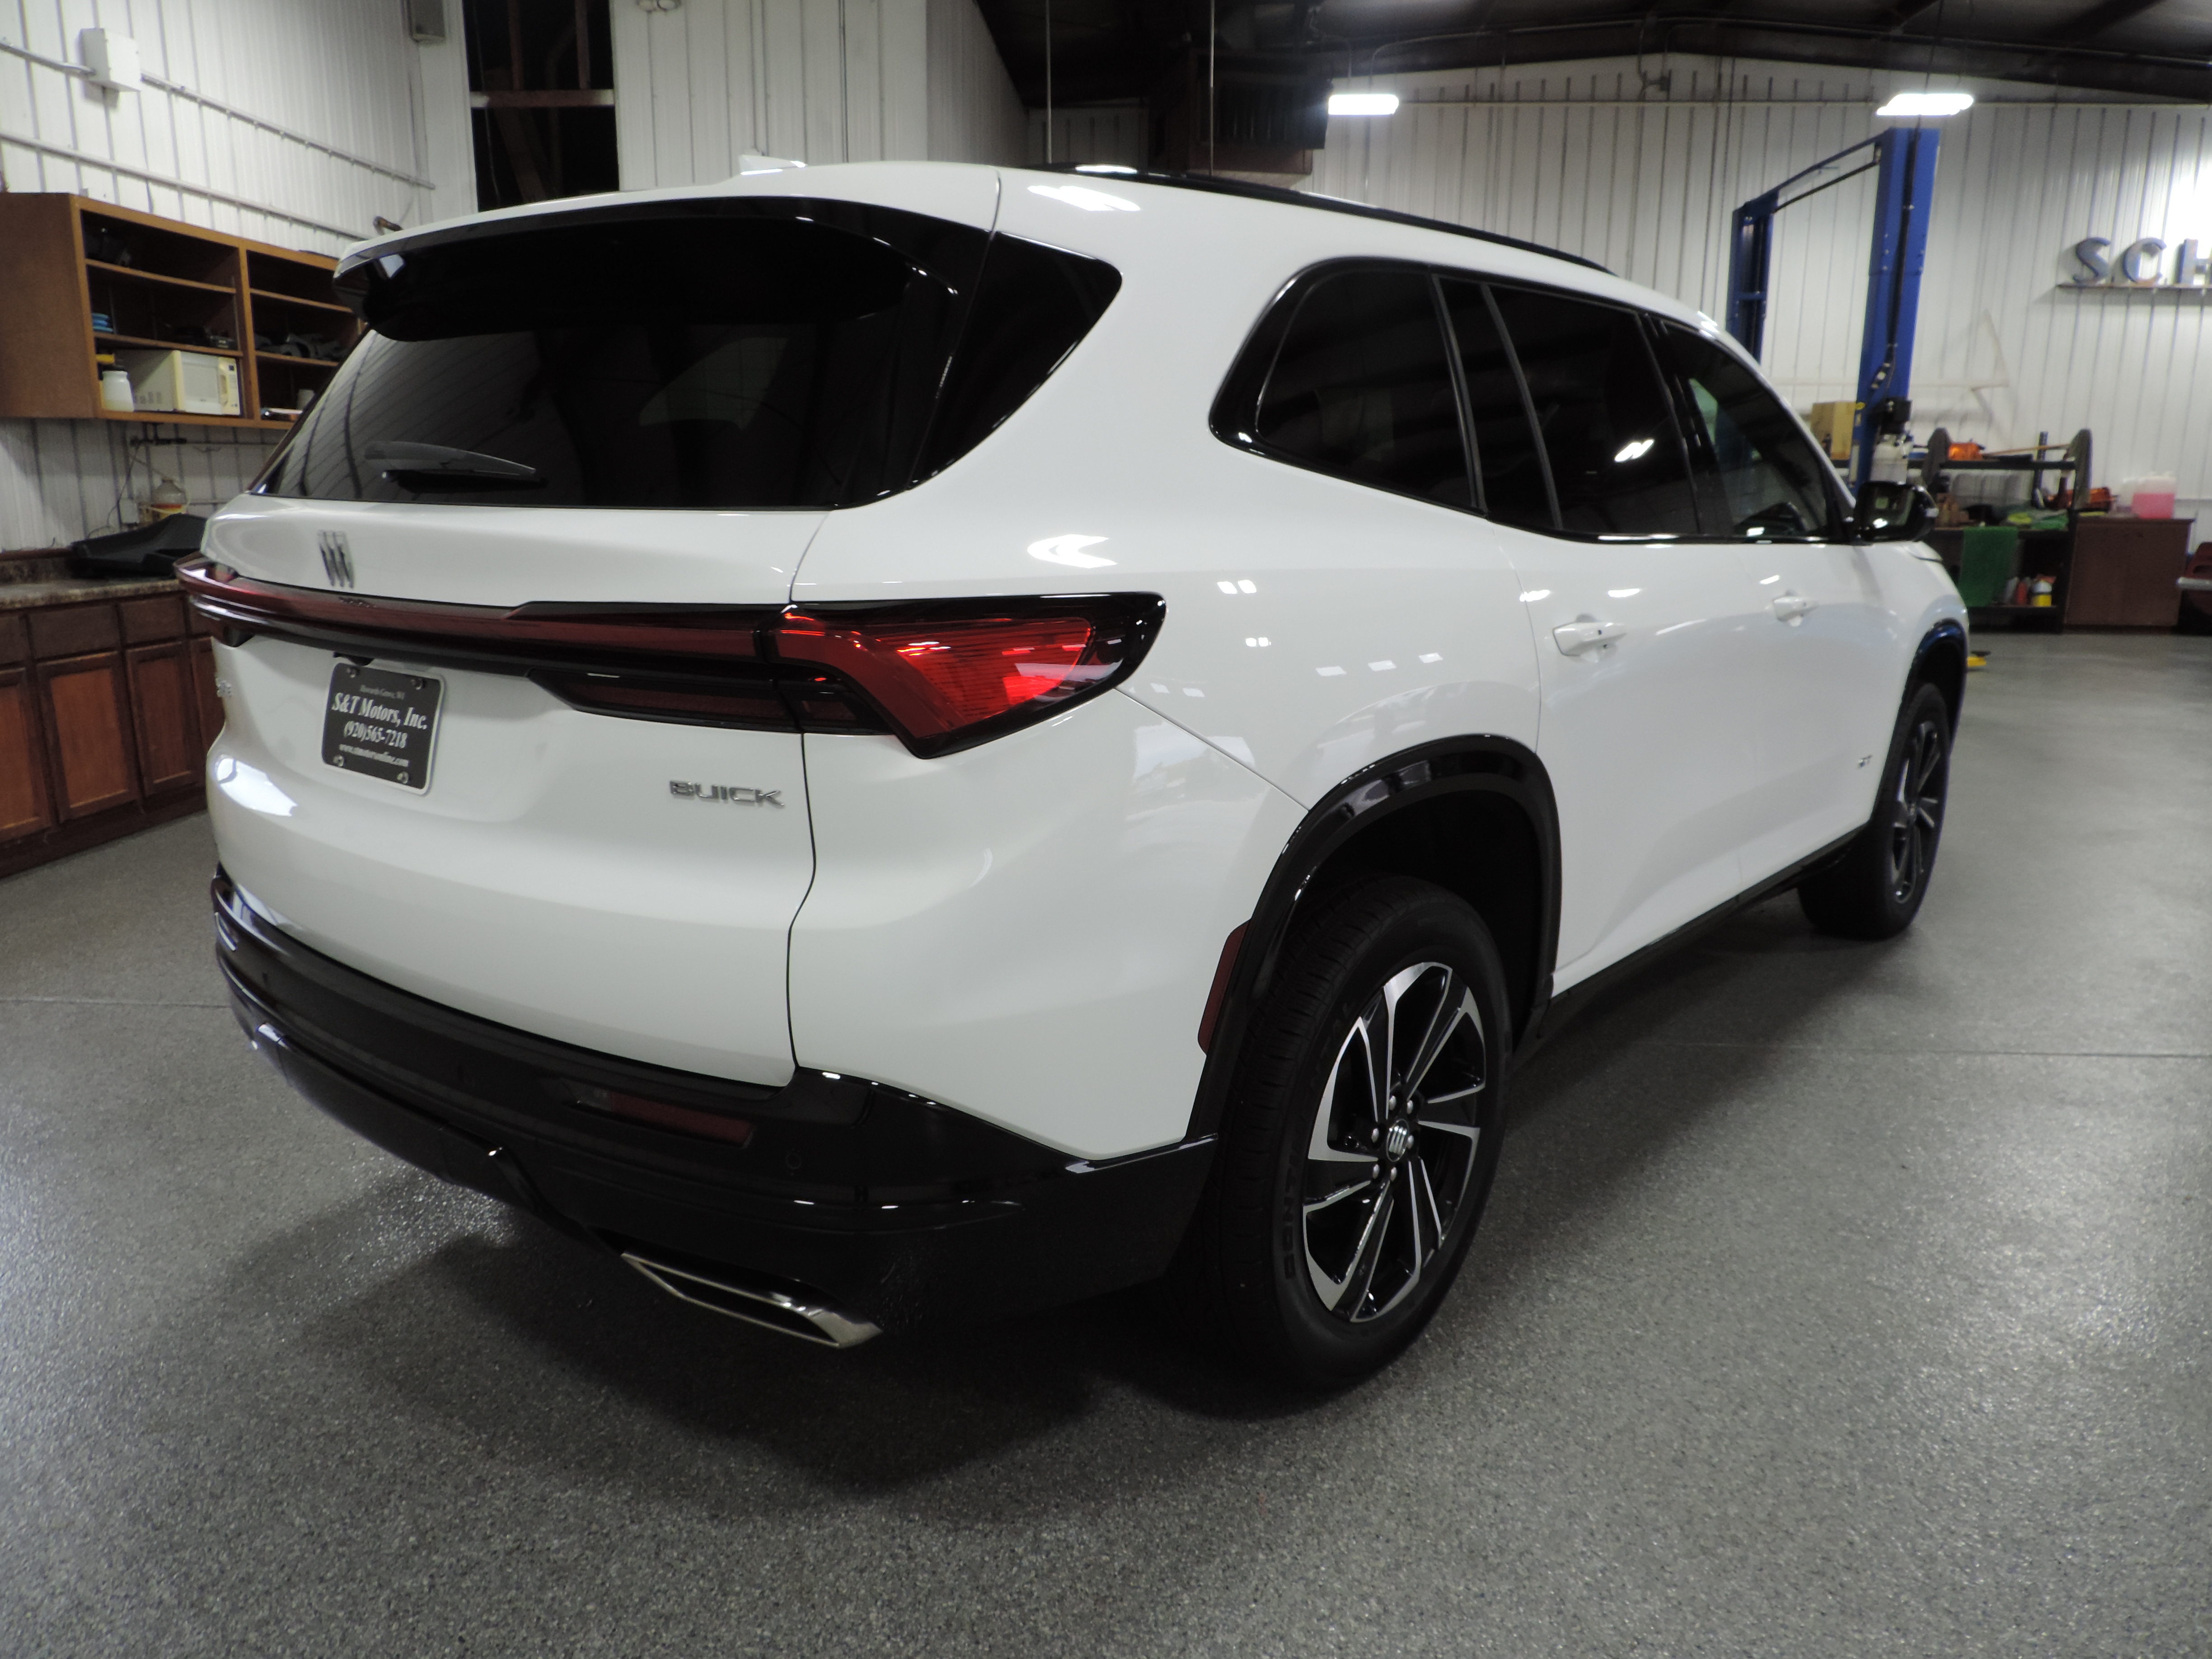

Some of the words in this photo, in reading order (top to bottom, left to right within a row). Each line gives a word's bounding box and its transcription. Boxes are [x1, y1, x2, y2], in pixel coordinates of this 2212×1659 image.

[332, 692, 361, 714] S&T
[358, 698, 401, 727] Motors,
[403, 707, 428, 730] Inc.
[344, 721, 408, 749] (920)565-7218
[669, 780, 784, 806] BUICK
